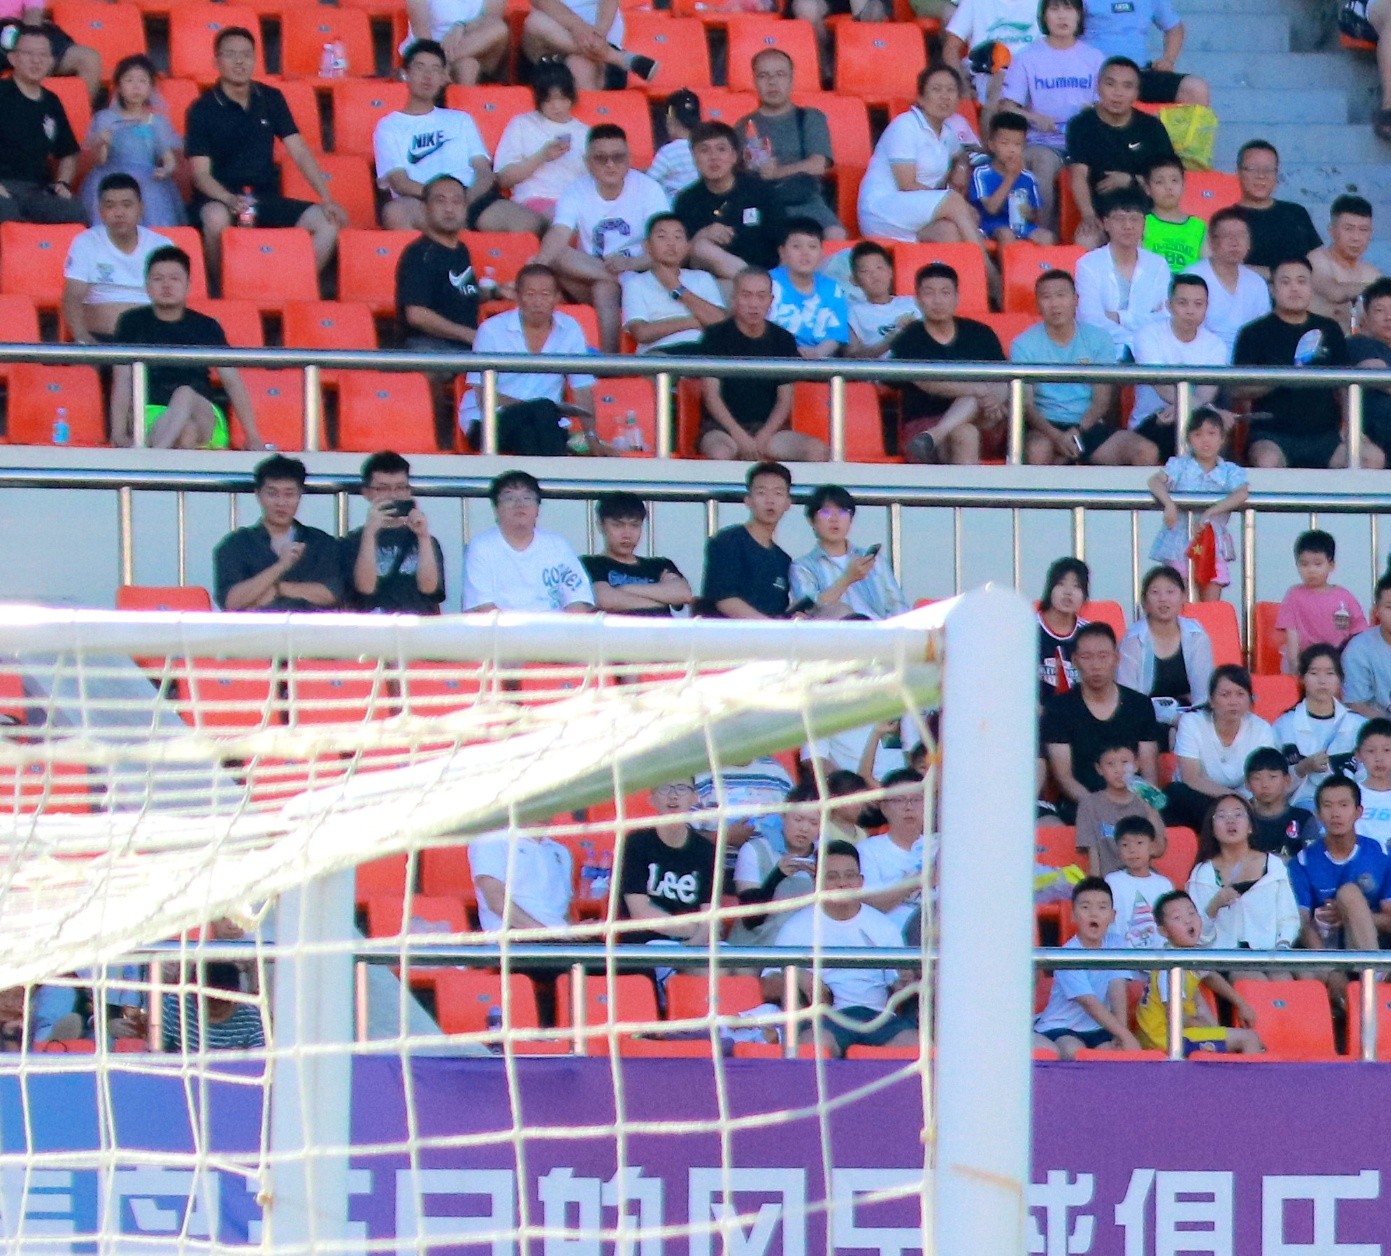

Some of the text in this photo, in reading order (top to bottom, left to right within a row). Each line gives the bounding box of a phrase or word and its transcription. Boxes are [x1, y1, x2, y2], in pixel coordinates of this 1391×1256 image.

[1034, 75, 1092, 90] hummel
[412, 130, 444, 149] NIKE
[647, 862, 698, 904] Lee
